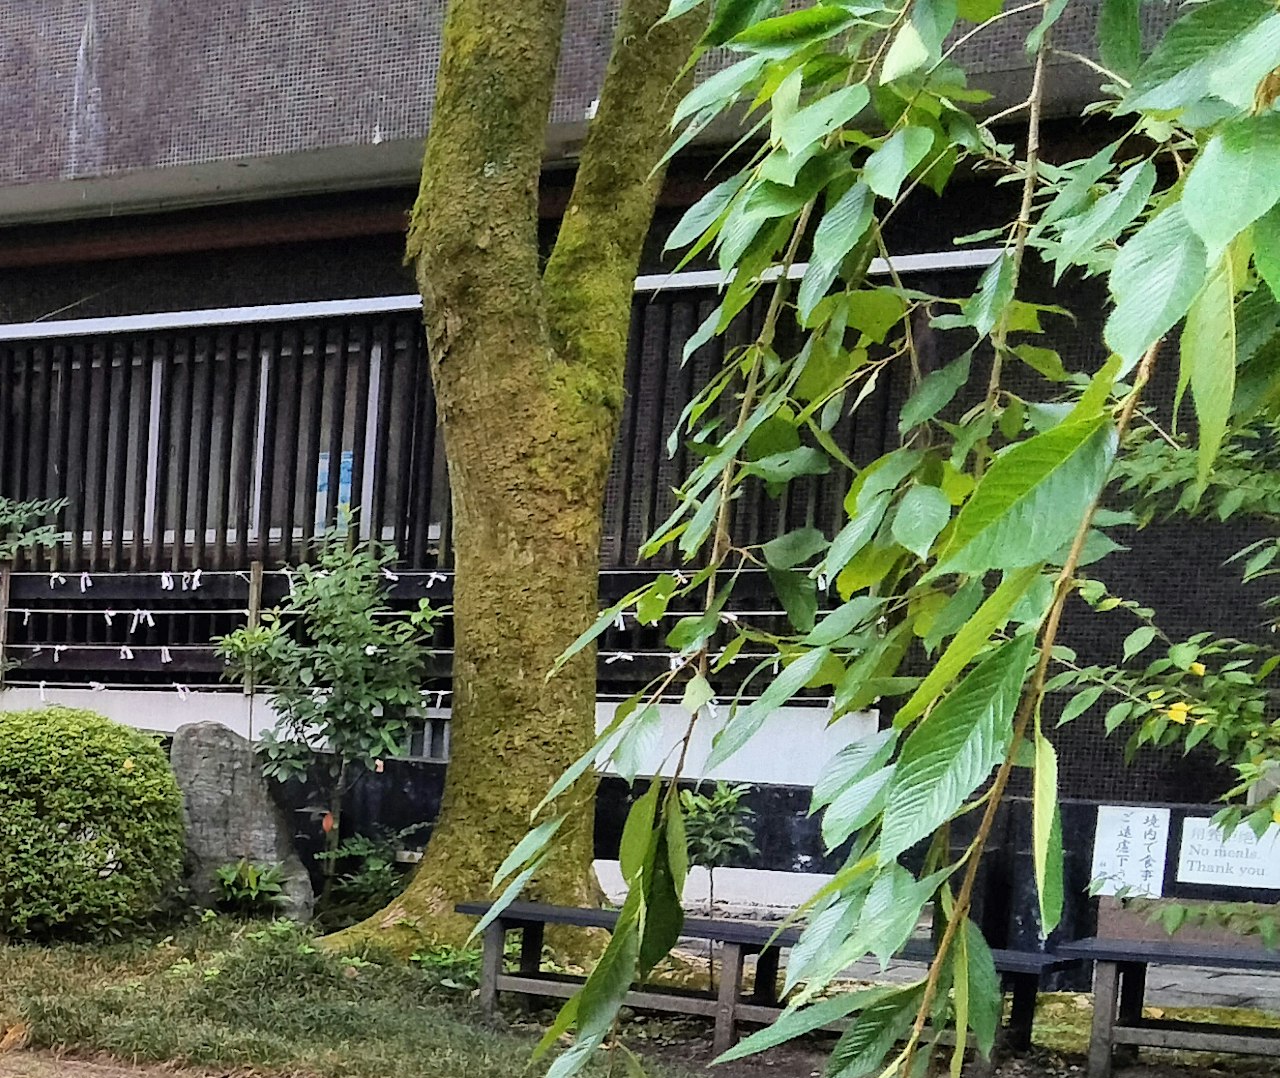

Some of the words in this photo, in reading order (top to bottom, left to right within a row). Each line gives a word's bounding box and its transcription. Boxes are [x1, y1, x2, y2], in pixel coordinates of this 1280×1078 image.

[1188, 844, 1209, 856] No
[1186, 860, 1234, 874] Thank
[1239, 866, 1265, 877] you
